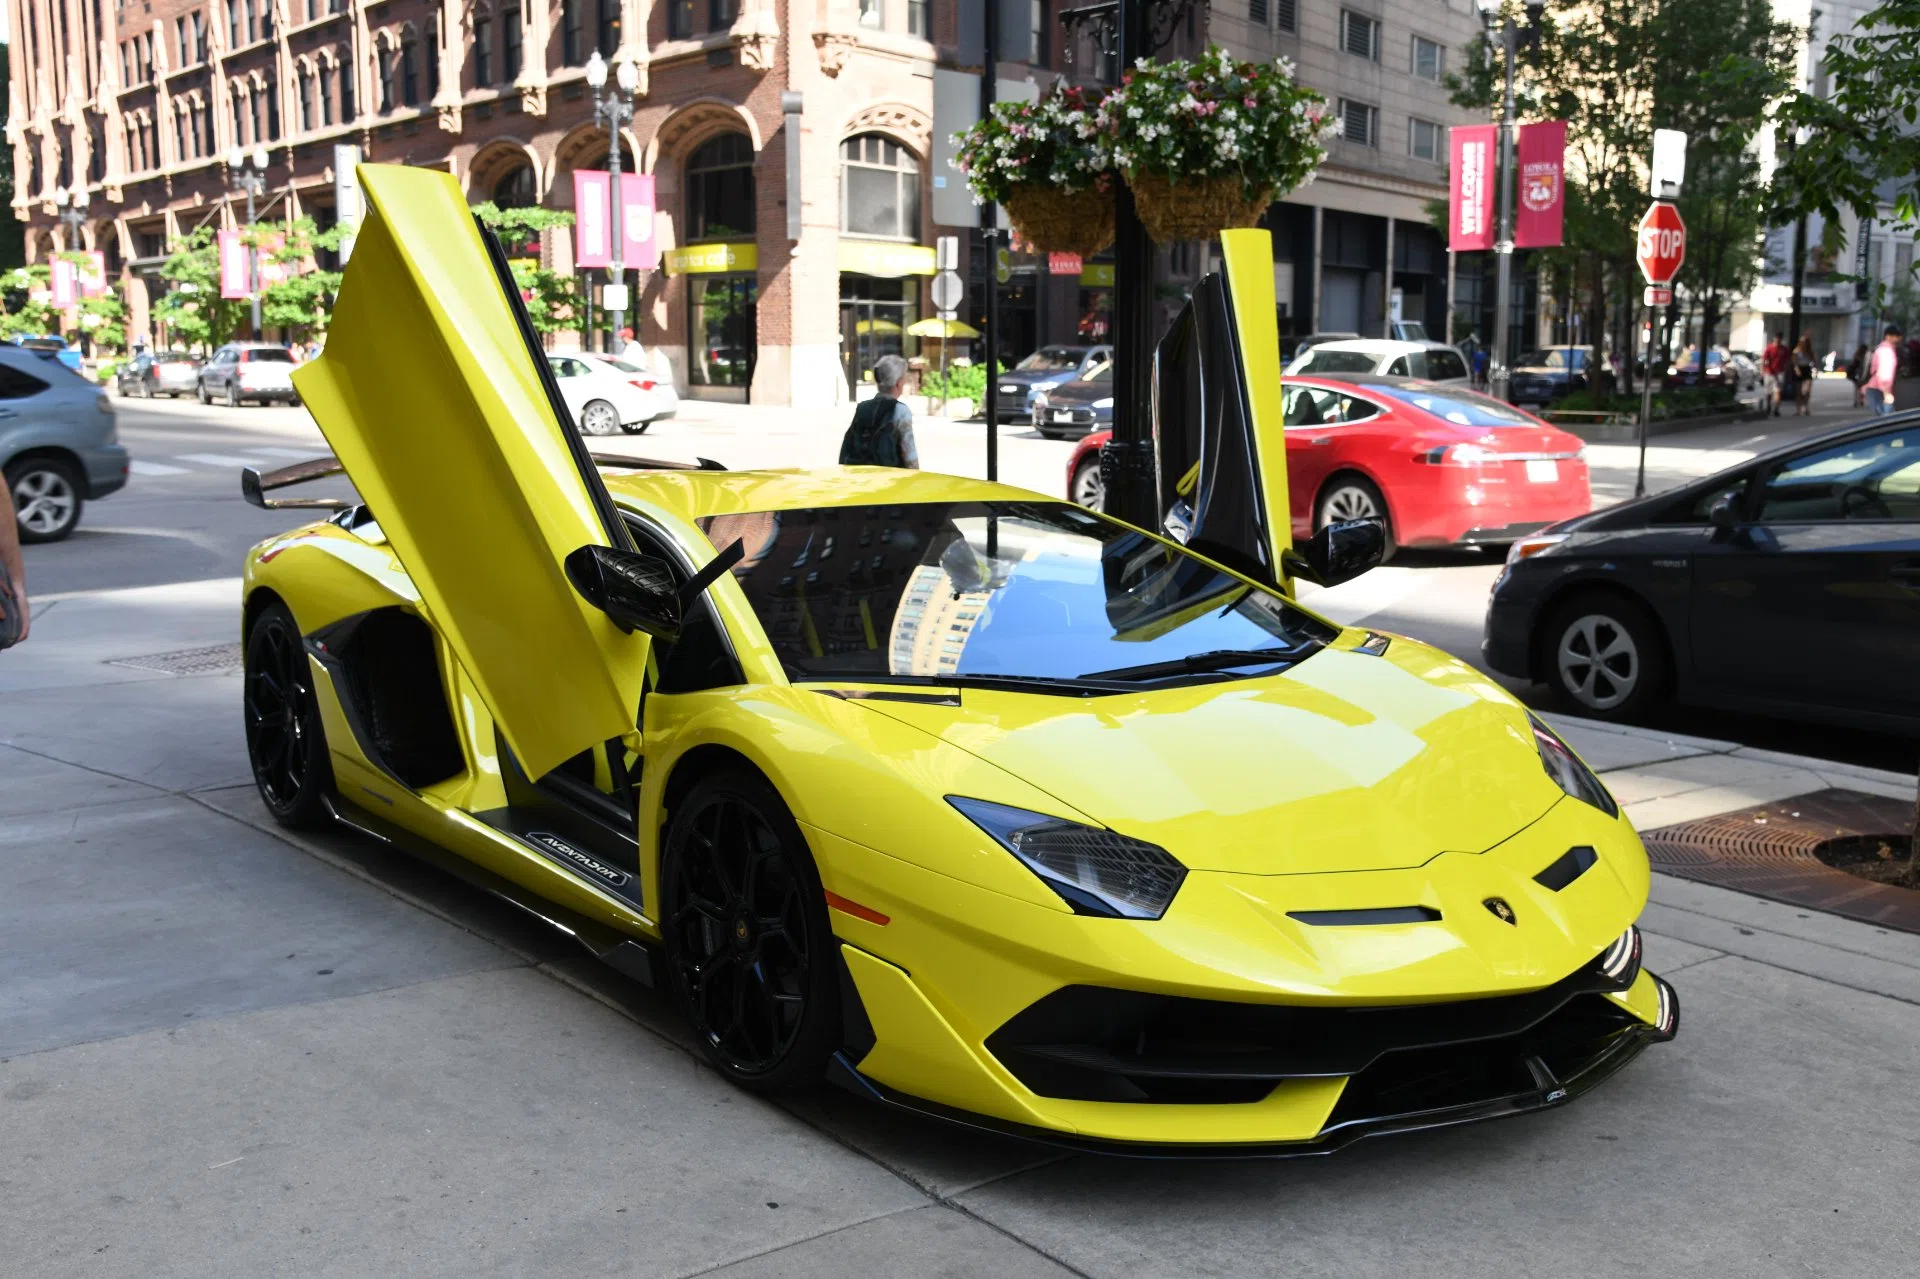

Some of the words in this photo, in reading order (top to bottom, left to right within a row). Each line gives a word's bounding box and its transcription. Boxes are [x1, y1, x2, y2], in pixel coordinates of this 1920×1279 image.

[1461, 141, 1476, 235] WELCOME
[1641, 227, 1682, 260] STOP
[542, 836, 619, 879] AVENTADOR
